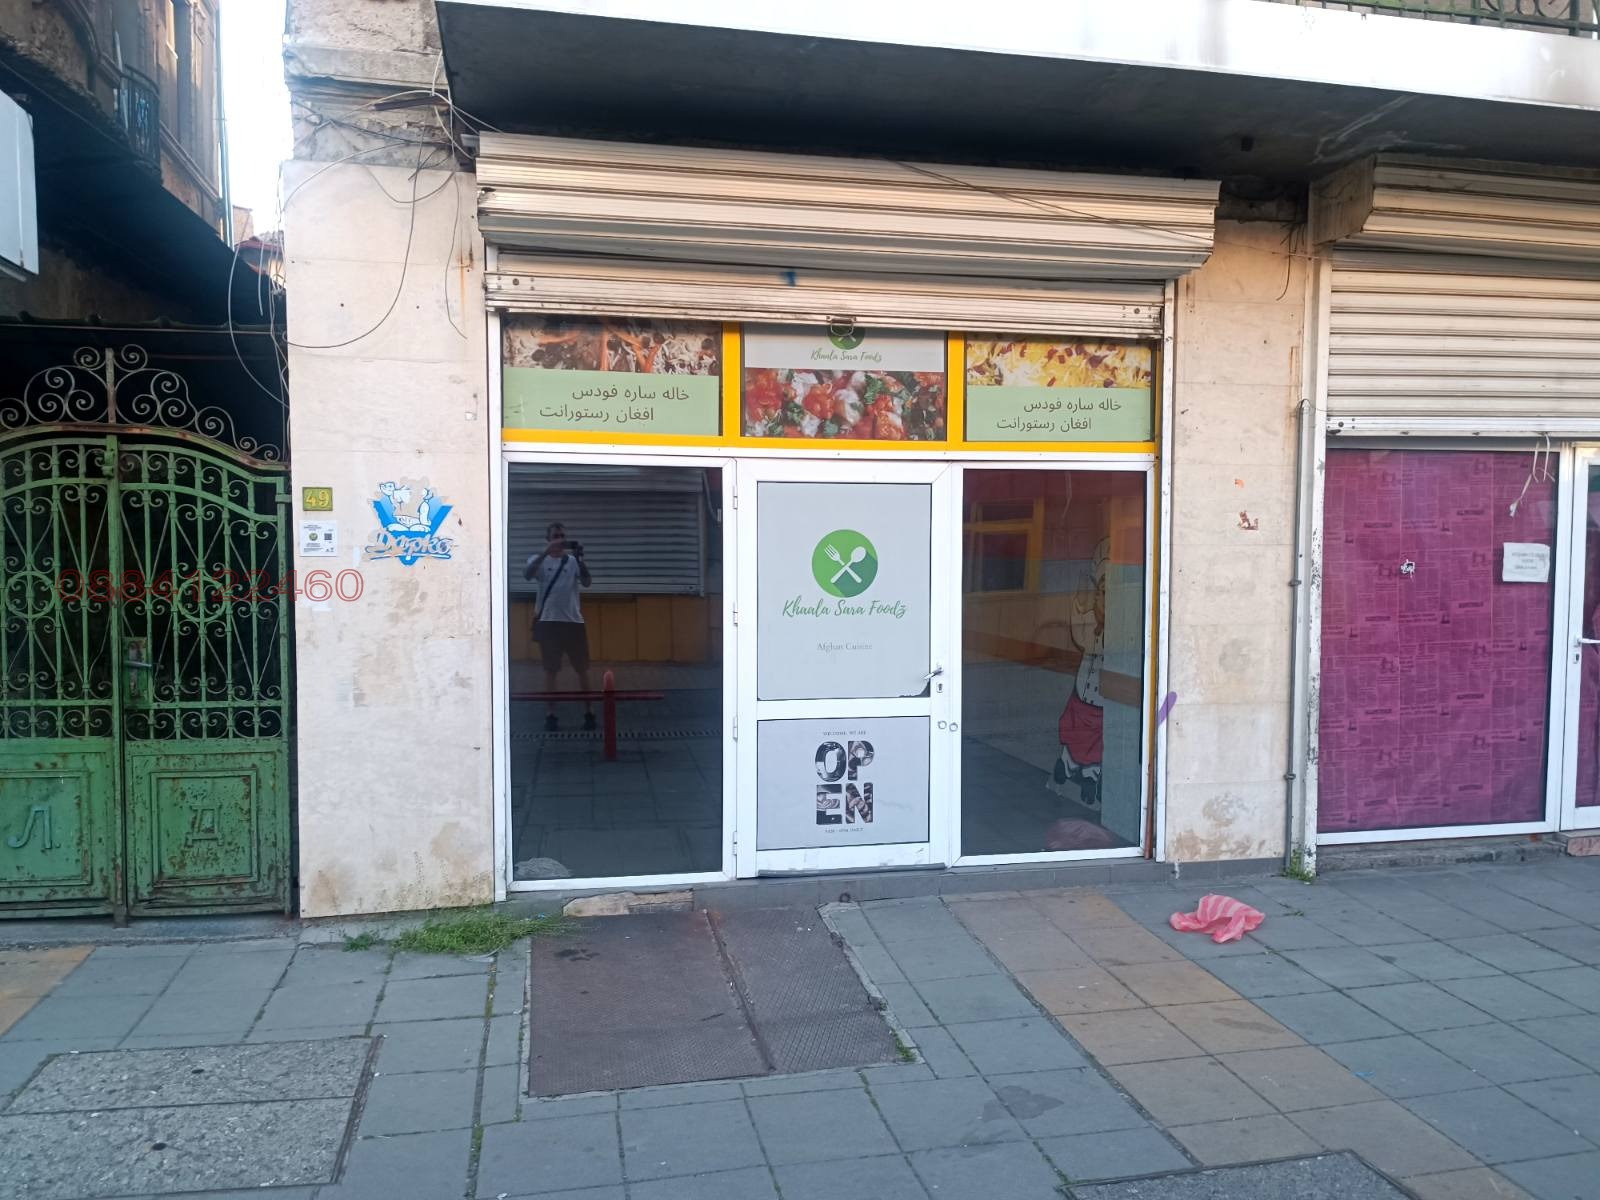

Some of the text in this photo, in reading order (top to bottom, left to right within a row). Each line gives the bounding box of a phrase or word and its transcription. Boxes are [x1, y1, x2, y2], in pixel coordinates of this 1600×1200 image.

[571, 384, 690, 402] خاله ساره فودس
[539, 404, 655, 424] افغان رستورانت
[1023, 397, 1122, 414] خاله ساره فودس
[996, 416, 1092, 433] افغان رستورانت
[305, 491, 330, 508] 49
[782, 595, 907, 619] Khaala Sara Foodz
